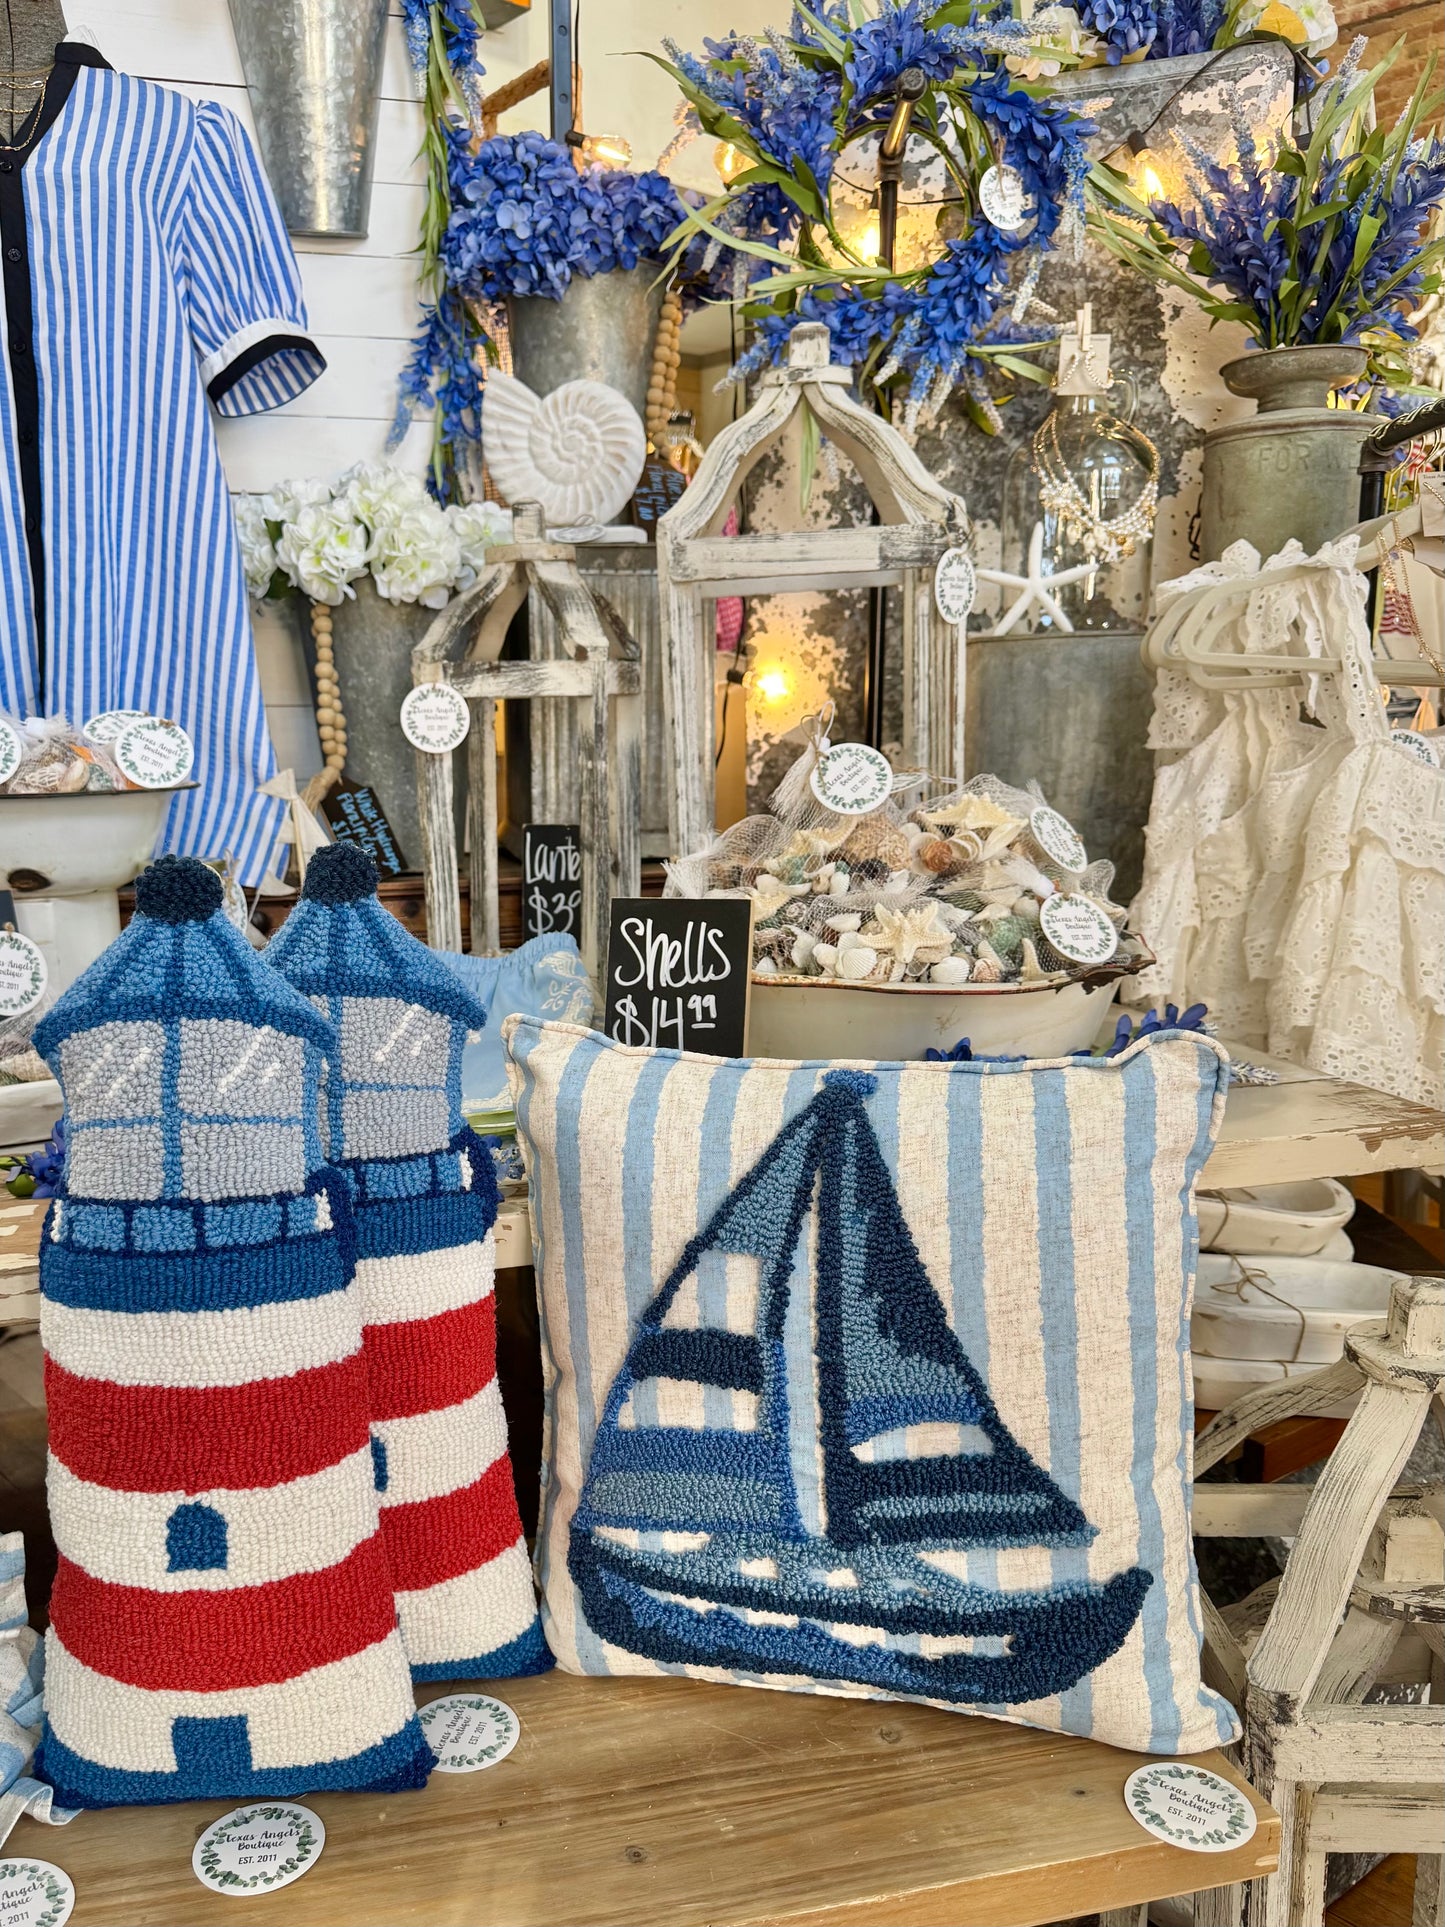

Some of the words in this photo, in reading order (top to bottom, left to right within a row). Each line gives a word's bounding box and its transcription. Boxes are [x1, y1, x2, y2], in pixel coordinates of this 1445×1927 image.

[525, 831, 581, 884] Lante
[614, 917, 732, 991] Shells
[0, 968, 24, 978] outique
[8, 960, 33, 971] Angels
[7, 982, 19, 990] 2011
[445, 1706, 466, 1729] Angels
[450, 1715, 472, 1744] Boutique
[468, 1734, 480, 1745] EST.
[474, 1721, 487, 1735] 2011
[1159, 1780, 1189, 1796] Texas
[1192, 1794, 1235, 1814] Angels
[1169, 1792, 1217, 1816] Boutique
[1167, 1806, 1183, 1818] EST.
[1186, 1813, 1207, 1826] 2011
[226, 1834, 258, 1843] Texas
[260, 1829, 301, 1840] Angels
[238, 1840, 286, 1851] Boutique
[238, 1856, 255, 1865] EST.
[257, 1854, 277, 1863] 2011
[2, 1882, 45, 1900] Angels
[0, 1896, 33, 1911] tique
[7, 1912, 29, 1925] 2011
